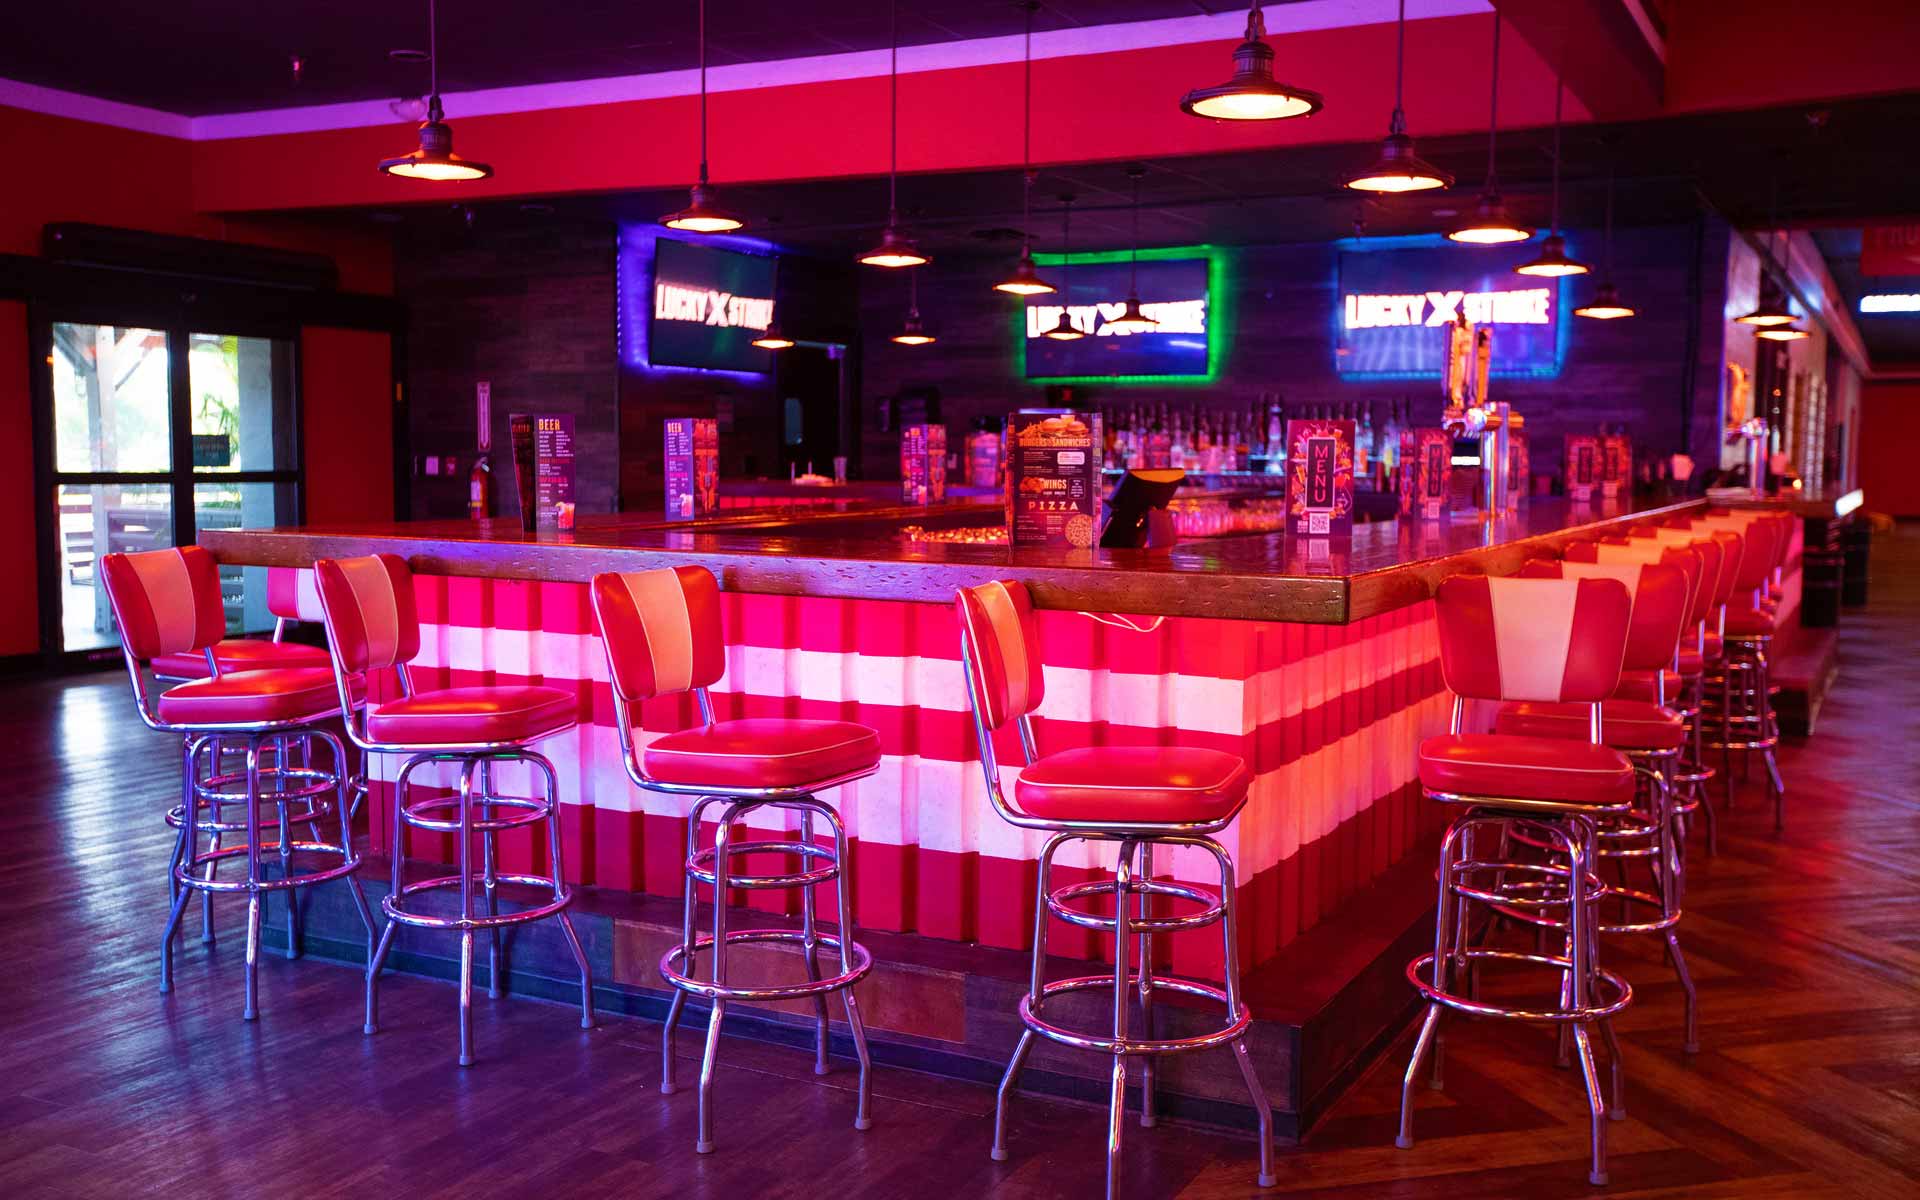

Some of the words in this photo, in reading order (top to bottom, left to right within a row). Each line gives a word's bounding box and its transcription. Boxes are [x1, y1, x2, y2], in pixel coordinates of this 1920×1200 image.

[655, 284, 709, 321] LUCKY
[1345, 294, 1426, 329] LUCKY
[538, 418, 561, 431] BEER
[1051, 437, 1091, 448] SANDWICHES
[1314, 444, 1329, 503] MENU
[1043, 478, 1067, 490] WINGS
[1028, 501, 1079, 511] PIZZA
